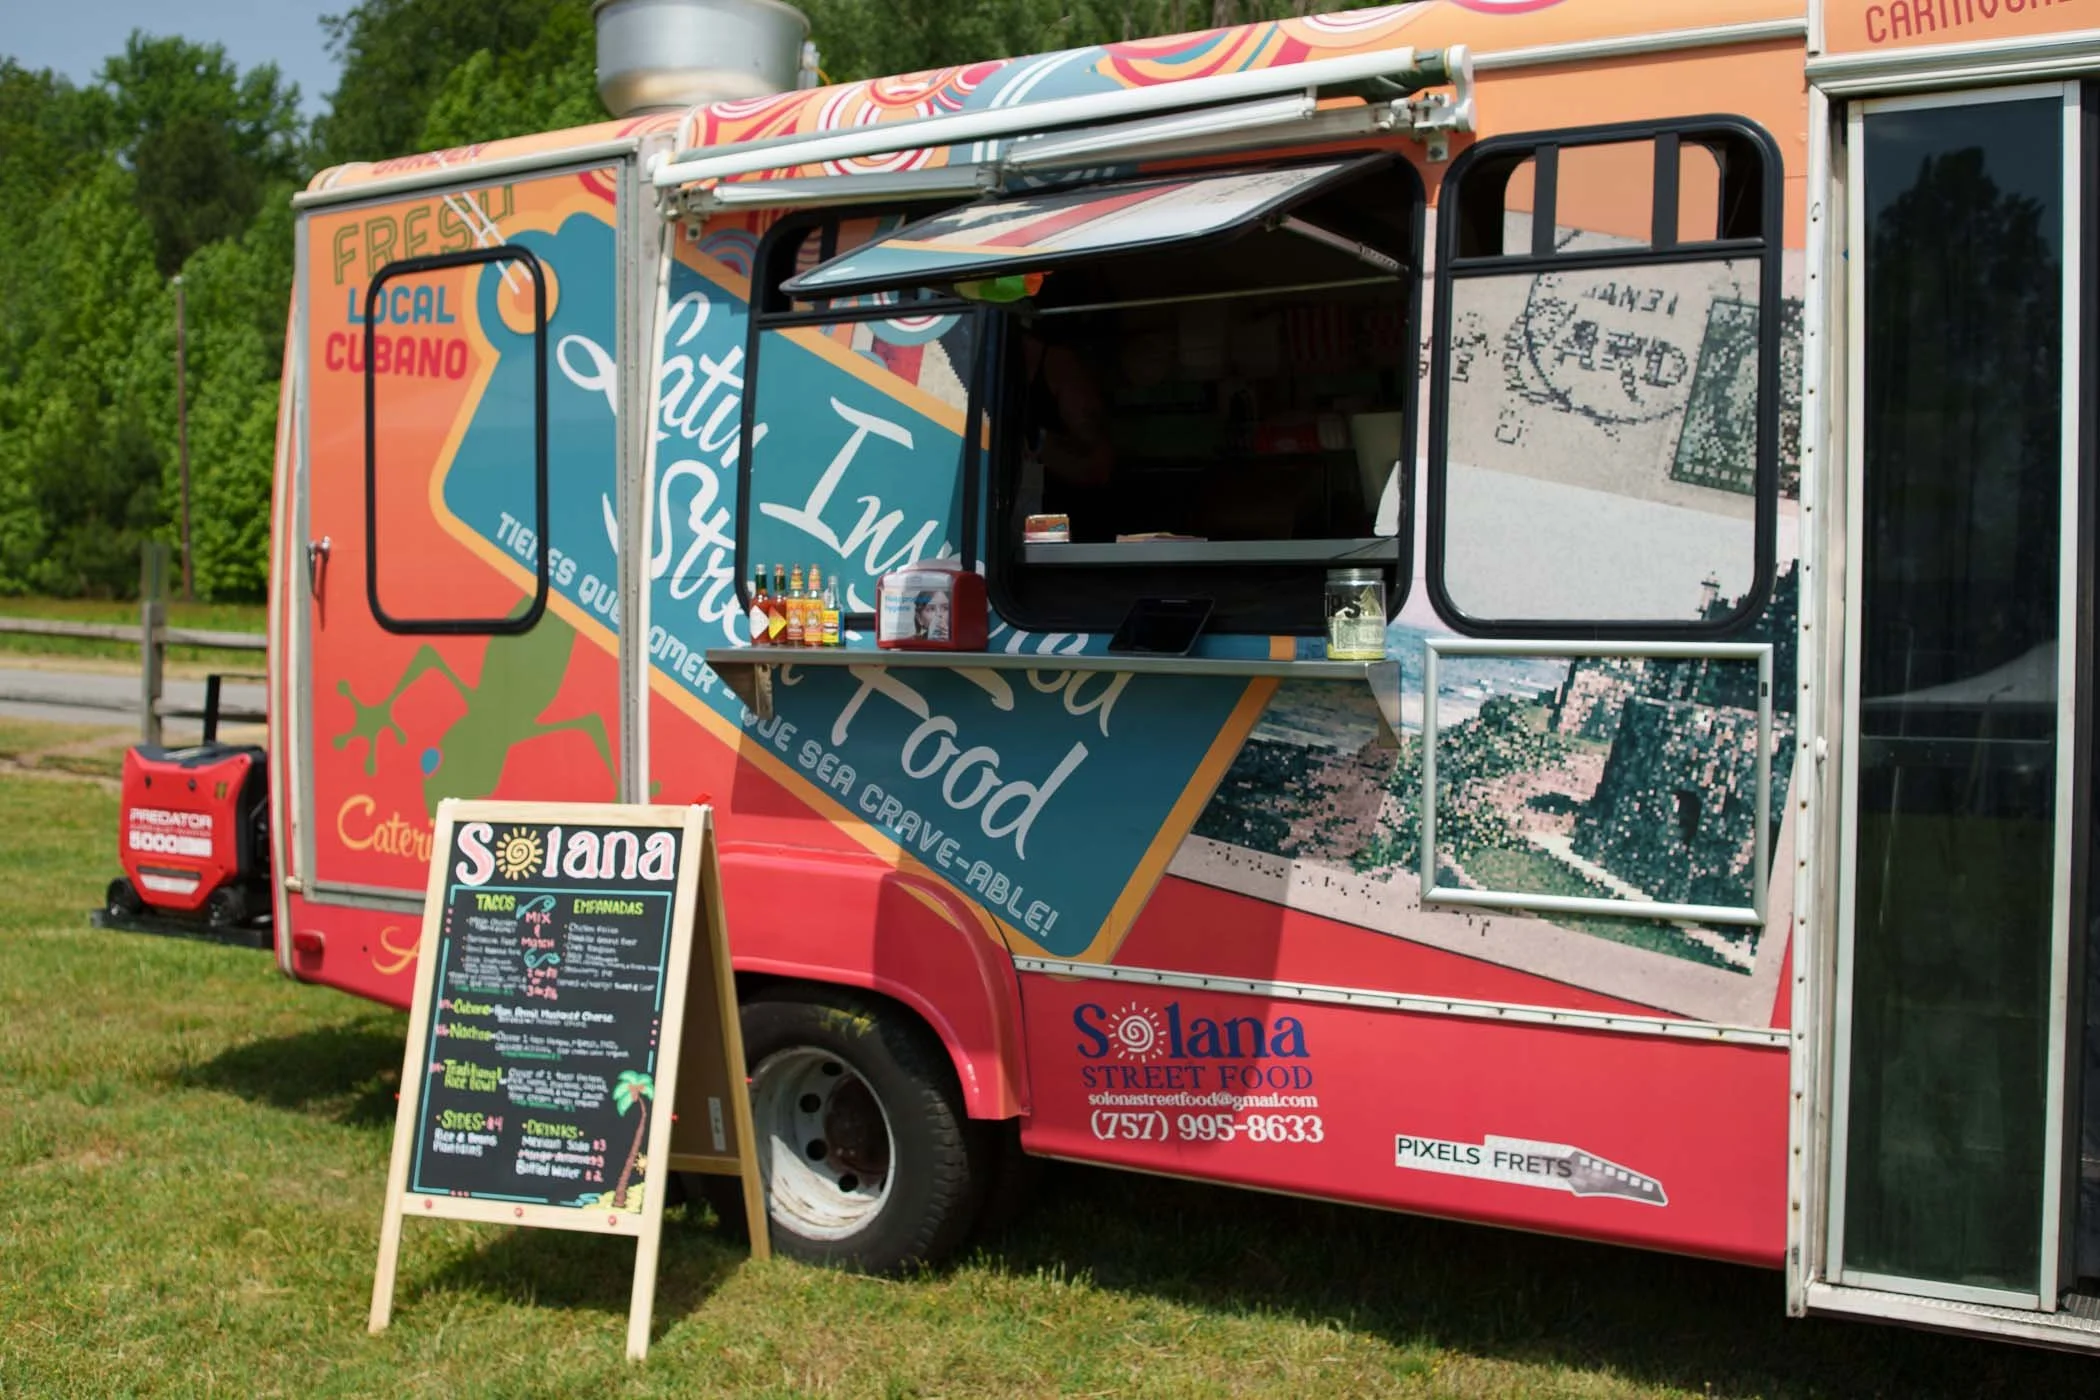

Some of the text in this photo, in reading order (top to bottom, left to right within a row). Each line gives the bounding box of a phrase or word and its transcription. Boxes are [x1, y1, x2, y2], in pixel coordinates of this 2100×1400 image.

[1865, 0, 2072, 43] CARNI
[347, 285, 456, 325] LOCAL
[325, 332, 468, 380] CUBANO
[649, 625, 718, 694] OMER
[798, 739, 856, 797] SEA
[859, 784, 1059, 937] CRAVE-ABLE!
[129, 808, 213, 831] PREDATOR
[337, 793, 435, 863] Cateri
[475, 893, 516, 912] TACOS
[525, 911, 552, 924] MIX
[573, 898, 644, 916] EMPANADAS
[1073, 1001, 1311, 1062] Solana
[1081, 1064, 1313, 1090] STREET FOOD
[441, 1109, 484, 1131] SIDES
[527, 1119, 578, 1139] DRINKS
[1091, 1109, 1325, 1143] (757) 995-8633
[1397, 1137, 1573, 1178] PIXELS FRETS
